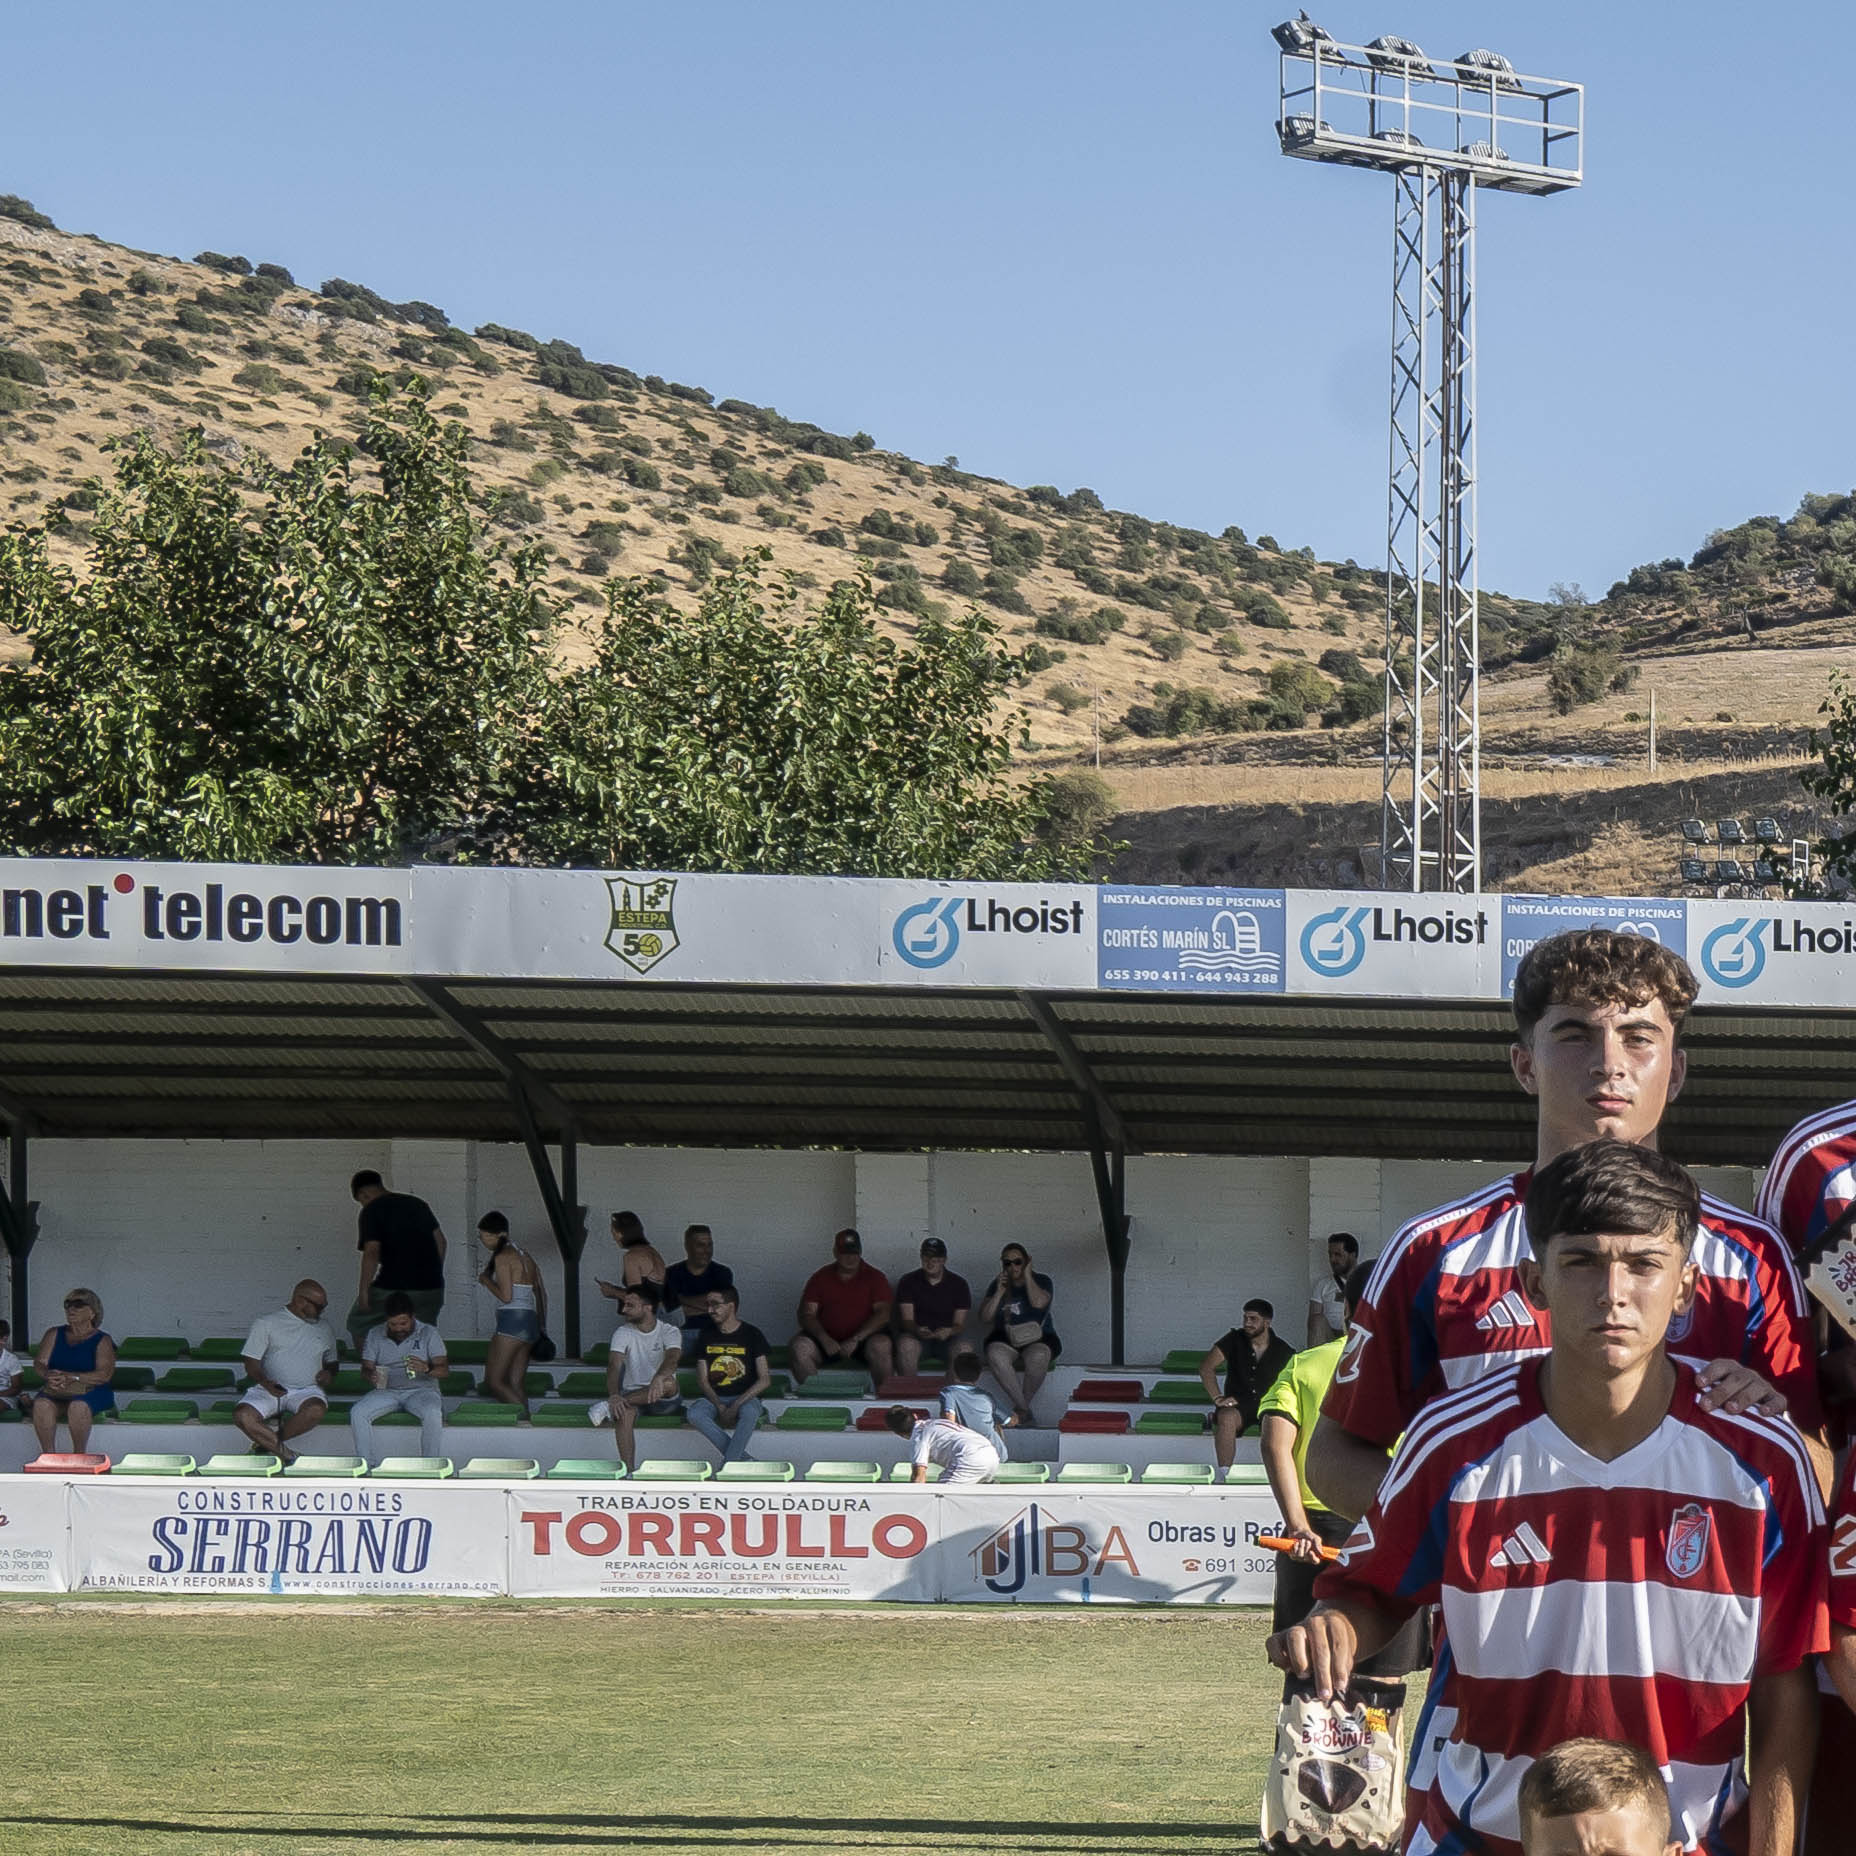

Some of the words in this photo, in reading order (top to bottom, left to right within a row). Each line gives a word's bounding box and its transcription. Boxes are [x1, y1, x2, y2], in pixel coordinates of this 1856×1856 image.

[1103, 894, 1204, 907] INSTALACIONES
[1207, 897, 1223, 907] DE
[1226, 898, 1282, 909] PISCINAS
[142, 883, 401, 947] telecom
[618, 912, 667, 923] ESTEPA
[967, 898, 1084, 934] Lhoist
[1507, 905, 1605, 917] INSTALACIONES
[1608, 908, 1625, 918] DE
[1628, 908, 1683, 919] PISCINAS
[1373, 908, 1488, 945] Lhoist
[1103, 925, 1158, 949] CORTÉS
[1163, 927, 1208, 950] MARÍN
[1213, 931, 1230, 950] SL
[1105, 970, 1130, 981] 655
[1133, 970, 1157, 982] 390
[1161, 970, 1187, 982] 411
[1196, 971, 1221, 983] 644
[1225, 972, 1250, 984] 943
[1253, 972, 1278, 985] 288
[178, 1491, 402, 1511] CONSTRUCCIONES
[577, 1496, 690, 1510] TRABAJOS
[700, 1497, 728, 1510] EN
[738, 1497, 871, 1512] SOLDADURA
[521, 1511, 928, 1559] TORRULLO
[1148, 1521, 1215, 1543] Obras
[1223, 1527, 1236, 1547] y
[149, 1516, 433, 1574] SERRANO
[605, 1559, 688, 1571] REPARACIÓN
[693, 1560, 758, 1571] AGRÍCOLA
[763, 1561, 780, 1571] EN
[785, 1562, 847, 1572] GENERAL
[1205, 1558, 1237, 1572] 691
[82, 1574, 168, 1587] ALBAÑILERÍA
[172, 1577, 179, 1587] Y
[184, 1576, 254, 1588] REFORMAS
[666, 1572, 691, 1580] 762
[696, 1572, 719, 1580] 201
[730, 1573, 775, 1581] ESTEPA
[781, 1573, 840, 1582] (SEVILLA)
[1302, 1730, 1374, 1748] BROWNIE
